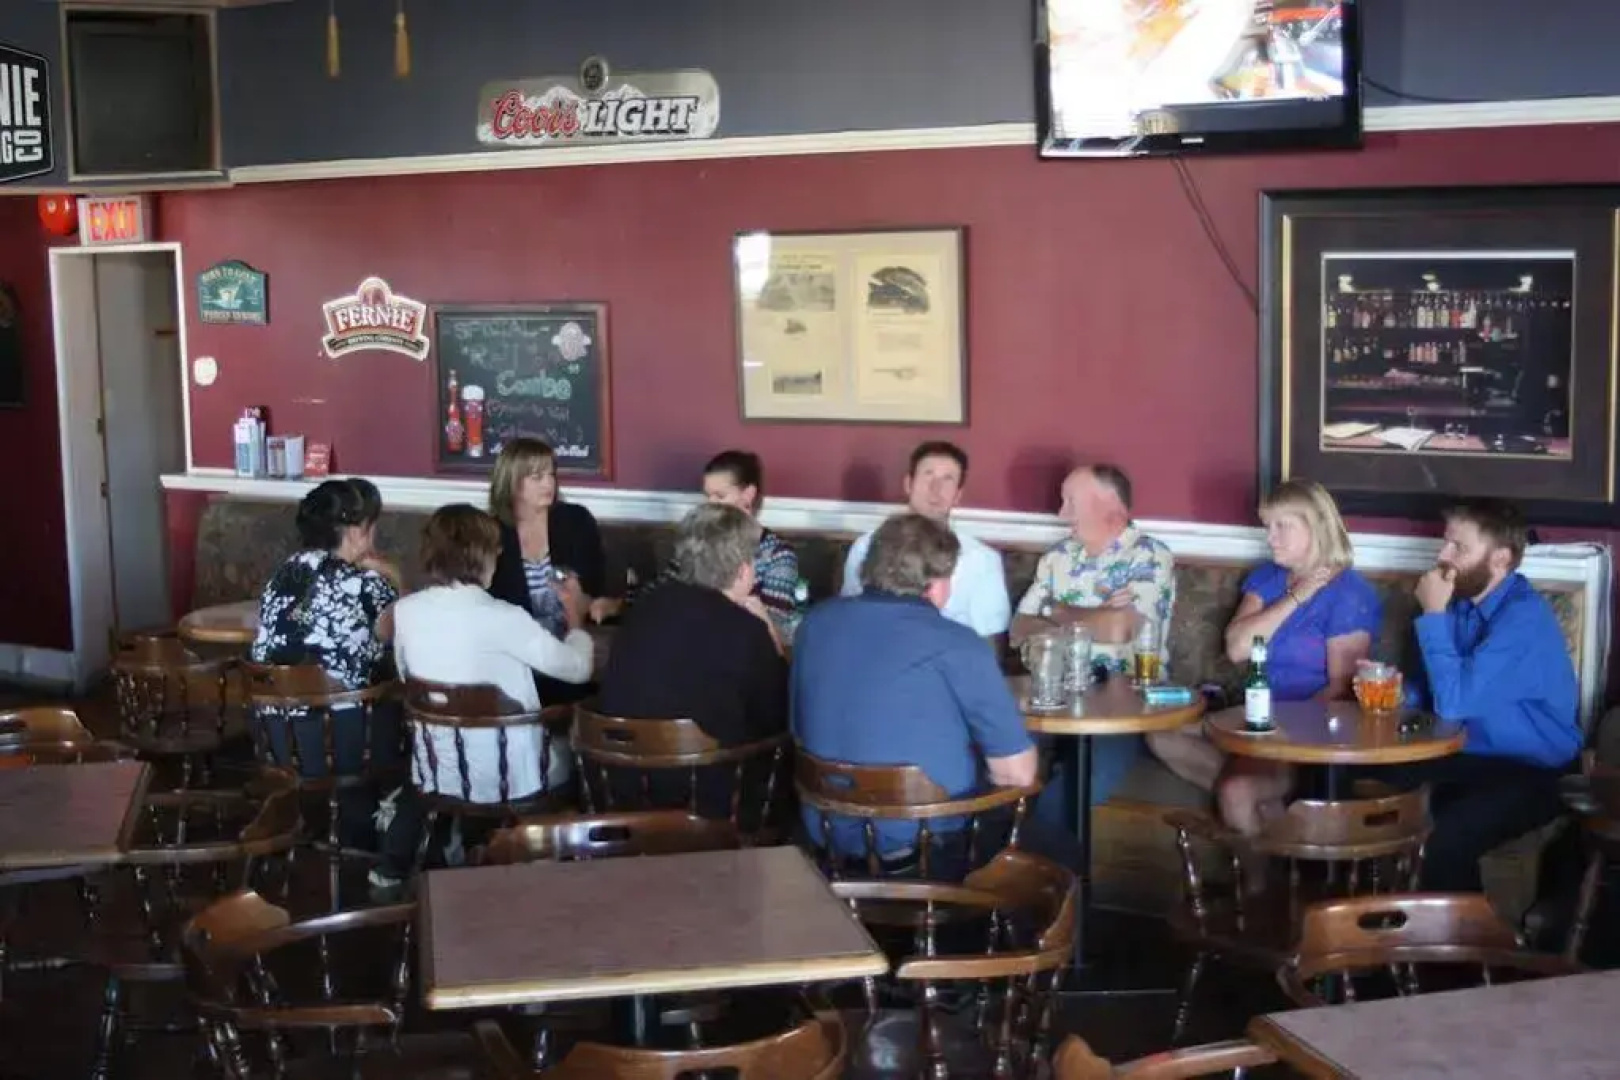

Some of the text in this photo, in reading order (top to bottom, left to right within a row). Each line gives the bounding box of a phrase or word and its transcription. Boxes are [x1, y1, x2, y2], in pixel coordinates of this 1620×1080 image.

[490, 89, 699, 140] Coors LIGHT
[89, 202, 138, 241] EXIT
[335, 304, 415, 332] FERNIE
